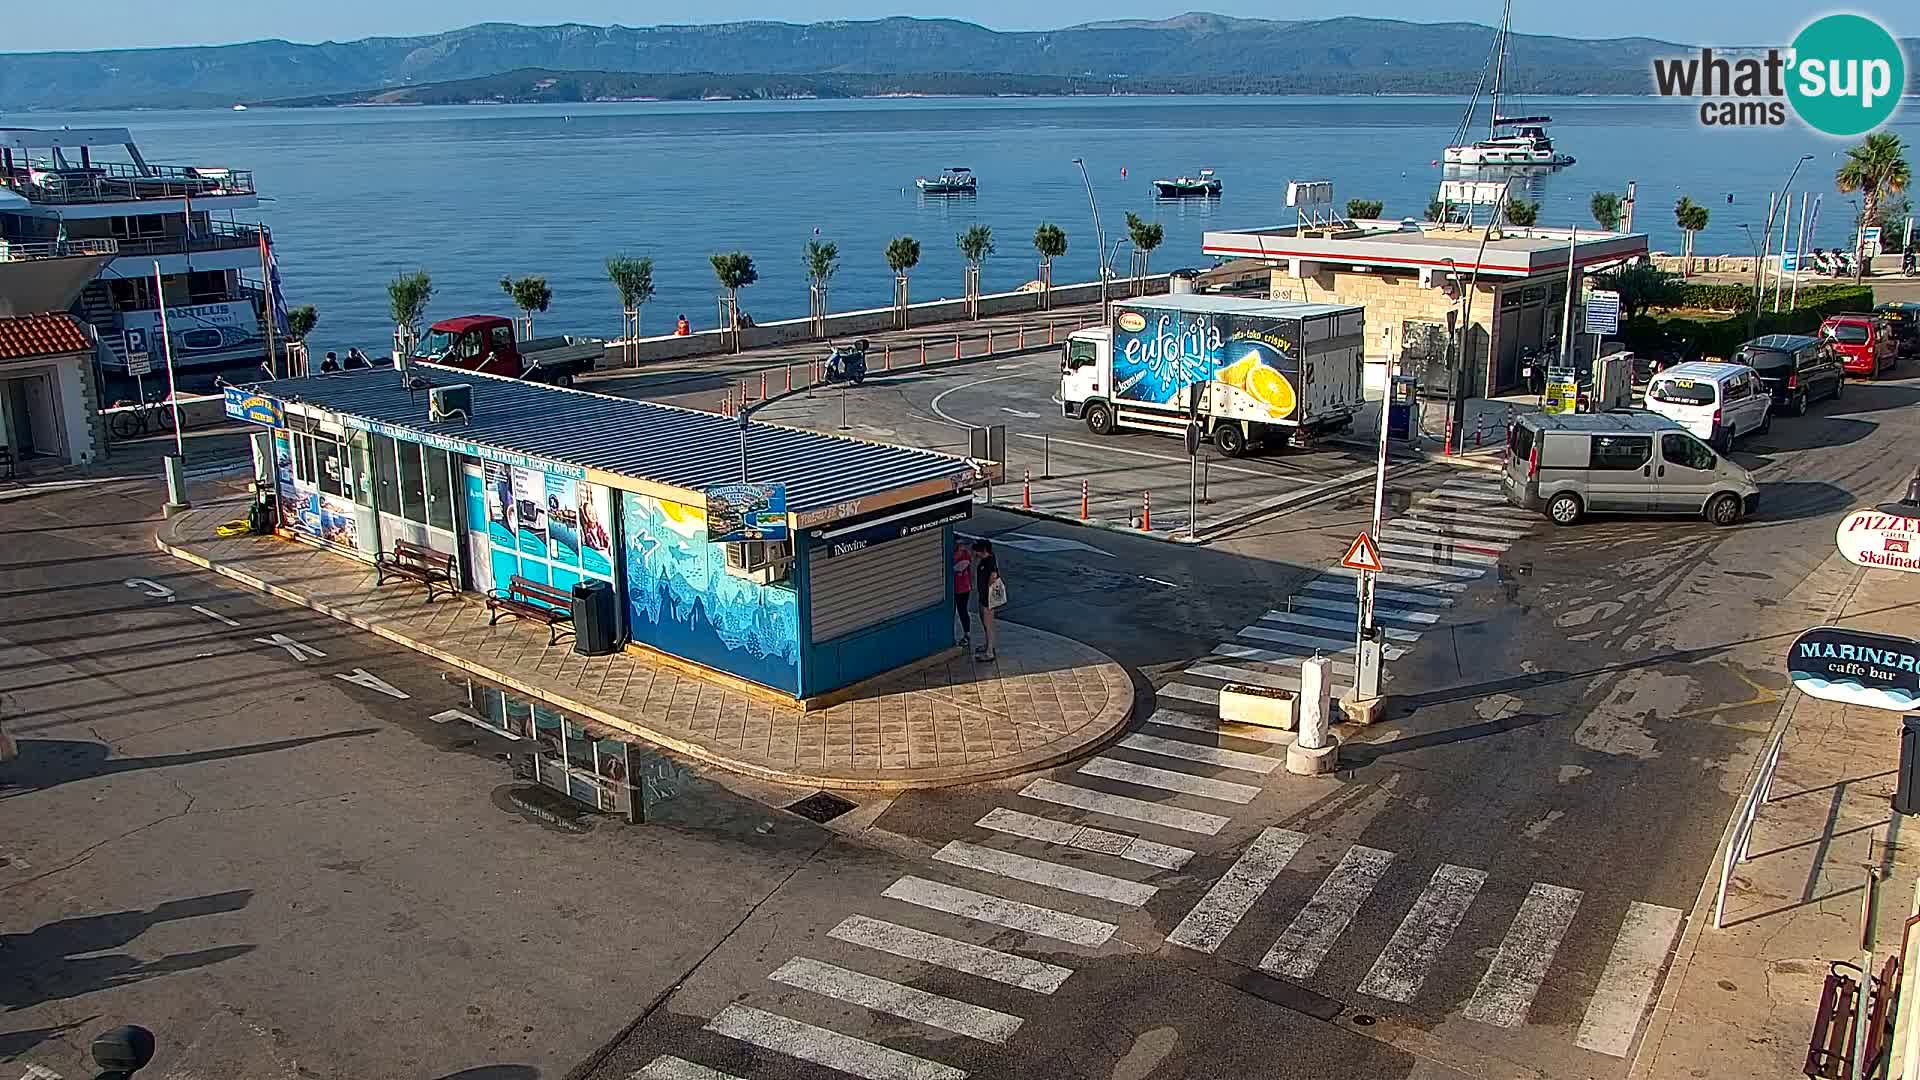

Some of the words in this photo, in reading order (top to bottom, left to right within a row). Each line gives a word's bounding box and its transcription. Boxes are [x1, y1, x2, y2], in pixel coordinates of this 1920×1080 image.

[1124, 314, 1226, 371] euforija
[1264, 334, 1291, 352] crispy
[1675, 379, 1694, 389] TAXI
[492, 448, 526, 467] STATION
[527, 457, 554, 474] TICKET
[553, 462, 582, 479] OFFICE
[1849, 516, 1920, 534] PIZZE
[1828, 661, 1866, 677] caffe
[1869, 666, 1896, 682] bar
